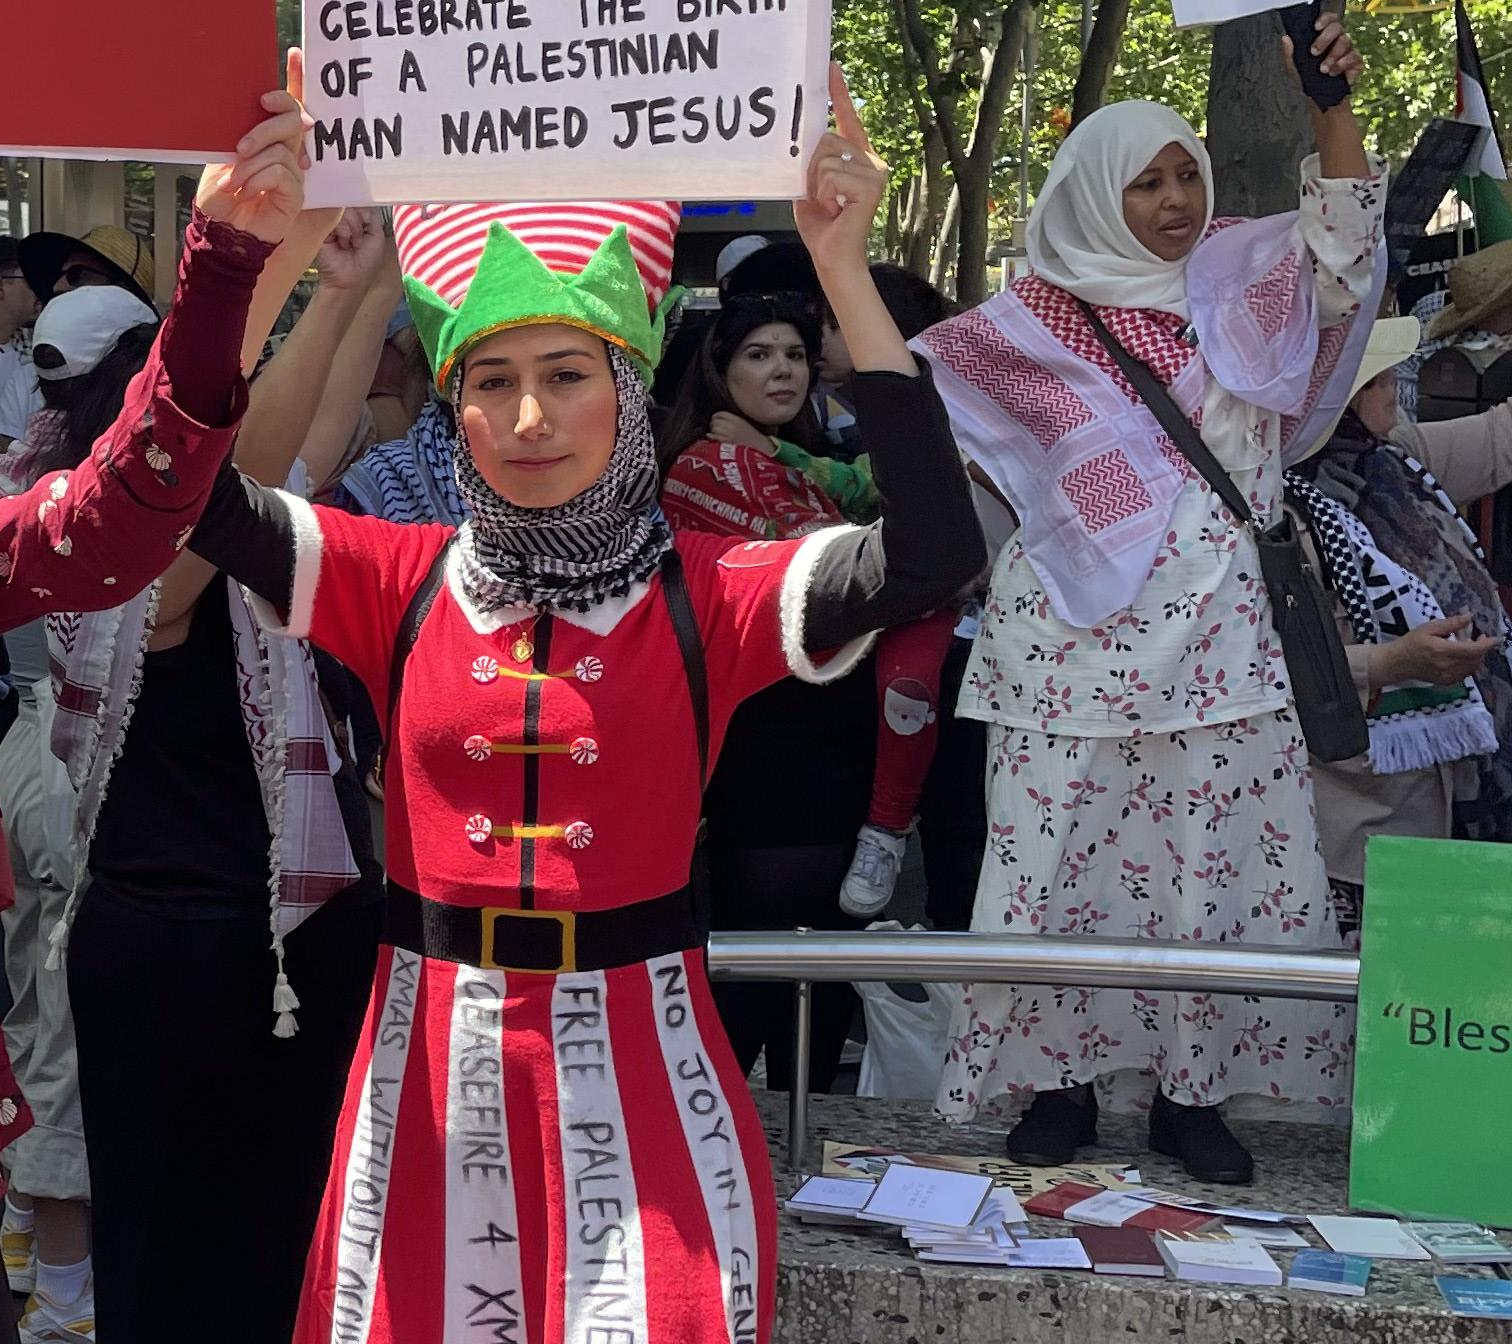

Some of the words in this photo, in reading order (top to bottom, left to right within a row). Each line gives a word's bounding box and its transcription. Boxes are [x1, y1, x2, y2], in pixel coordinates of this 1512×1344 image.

[321, 58, 372, 98] OF
[399, 50, 426, 93] A
[468, 30, 718, 87] PALESTINIAN
[314, 113, 402, 162] MAN
[442, 106, 587, 155] NAMED
[611, 84, 802, 157] JESUS!
[381, 951, 417, 1050] XMAS
[555, 986, 605, 1080] FREE
[459, 982, 507, 1183] CEASEFIRE
[656, 965, 685, 1028] NO
[677, 1053, 730, 1142] JOY
[715, 1168, 740, 1210] IN
[342, 1078, 400, 1261] WITHOUT
[468, 1222, 517, 1247] 4
